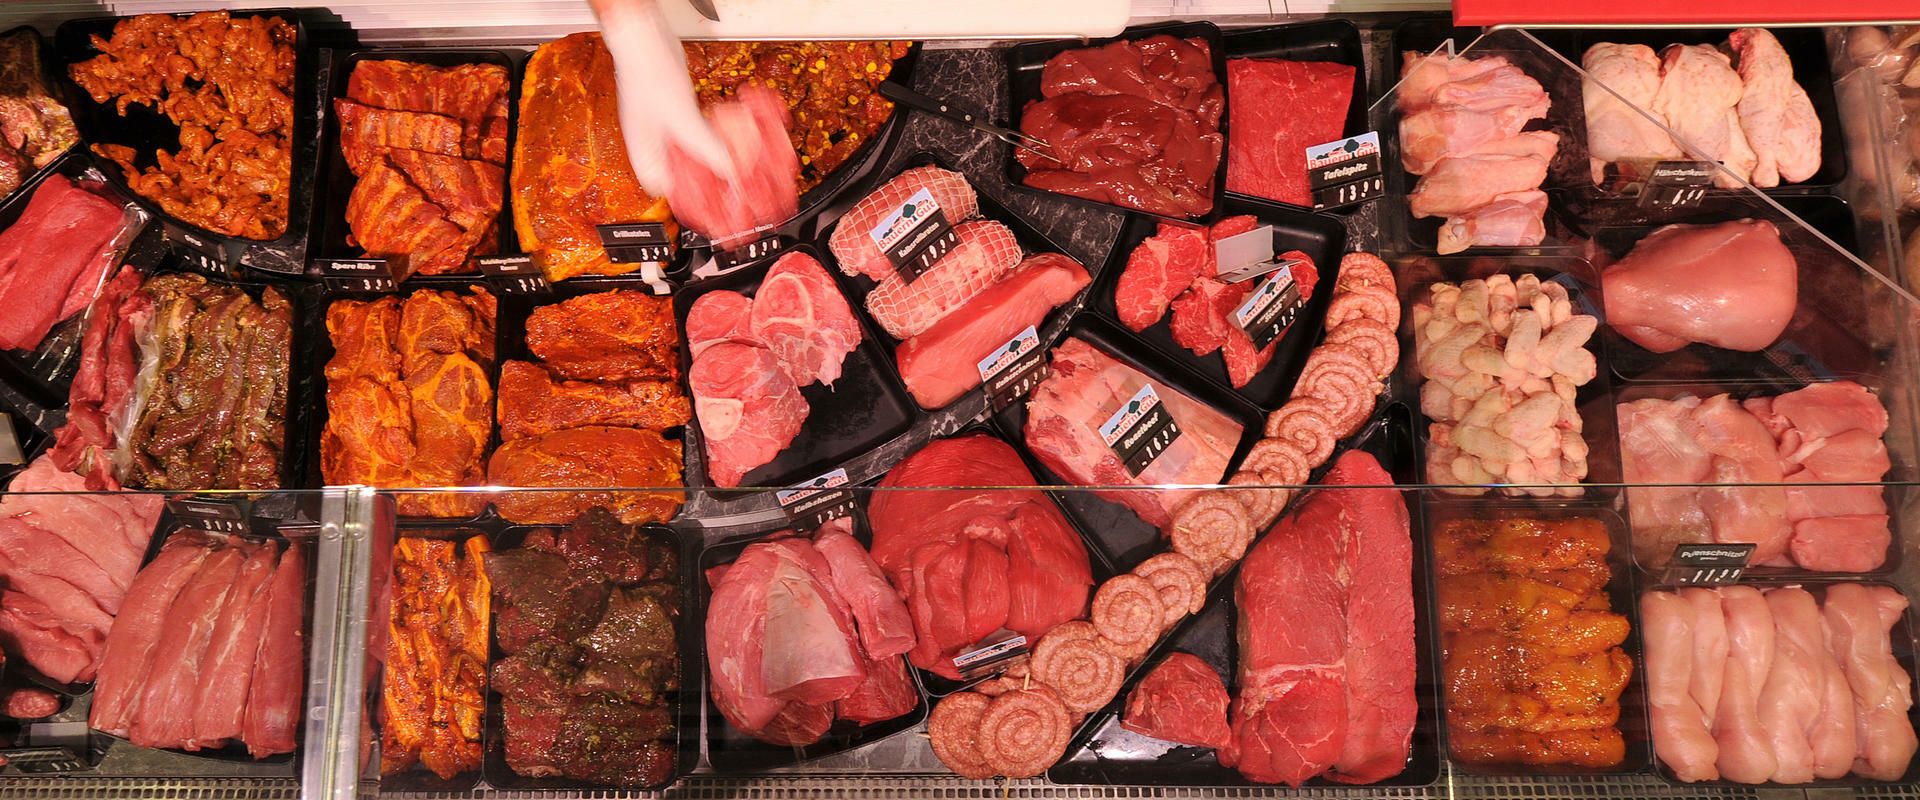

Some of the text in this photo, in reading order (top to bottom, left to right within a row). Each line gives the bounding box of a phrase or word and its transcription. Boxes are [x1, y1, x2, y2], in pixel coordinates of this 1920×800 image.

[1309, 146, 1379, 169] Bauern Gut
[1323, 163, 1368, 180] Tafelspitz
[878, 201, 937, 250] Bauern Gut
[982, 352, 1016, 380] Bauern
[1019, 337, 1038, 353] Gut
[1105, 395, 1158, 445] Bauern Gut
[1123, 412, 1159, 450] Roastbeef
